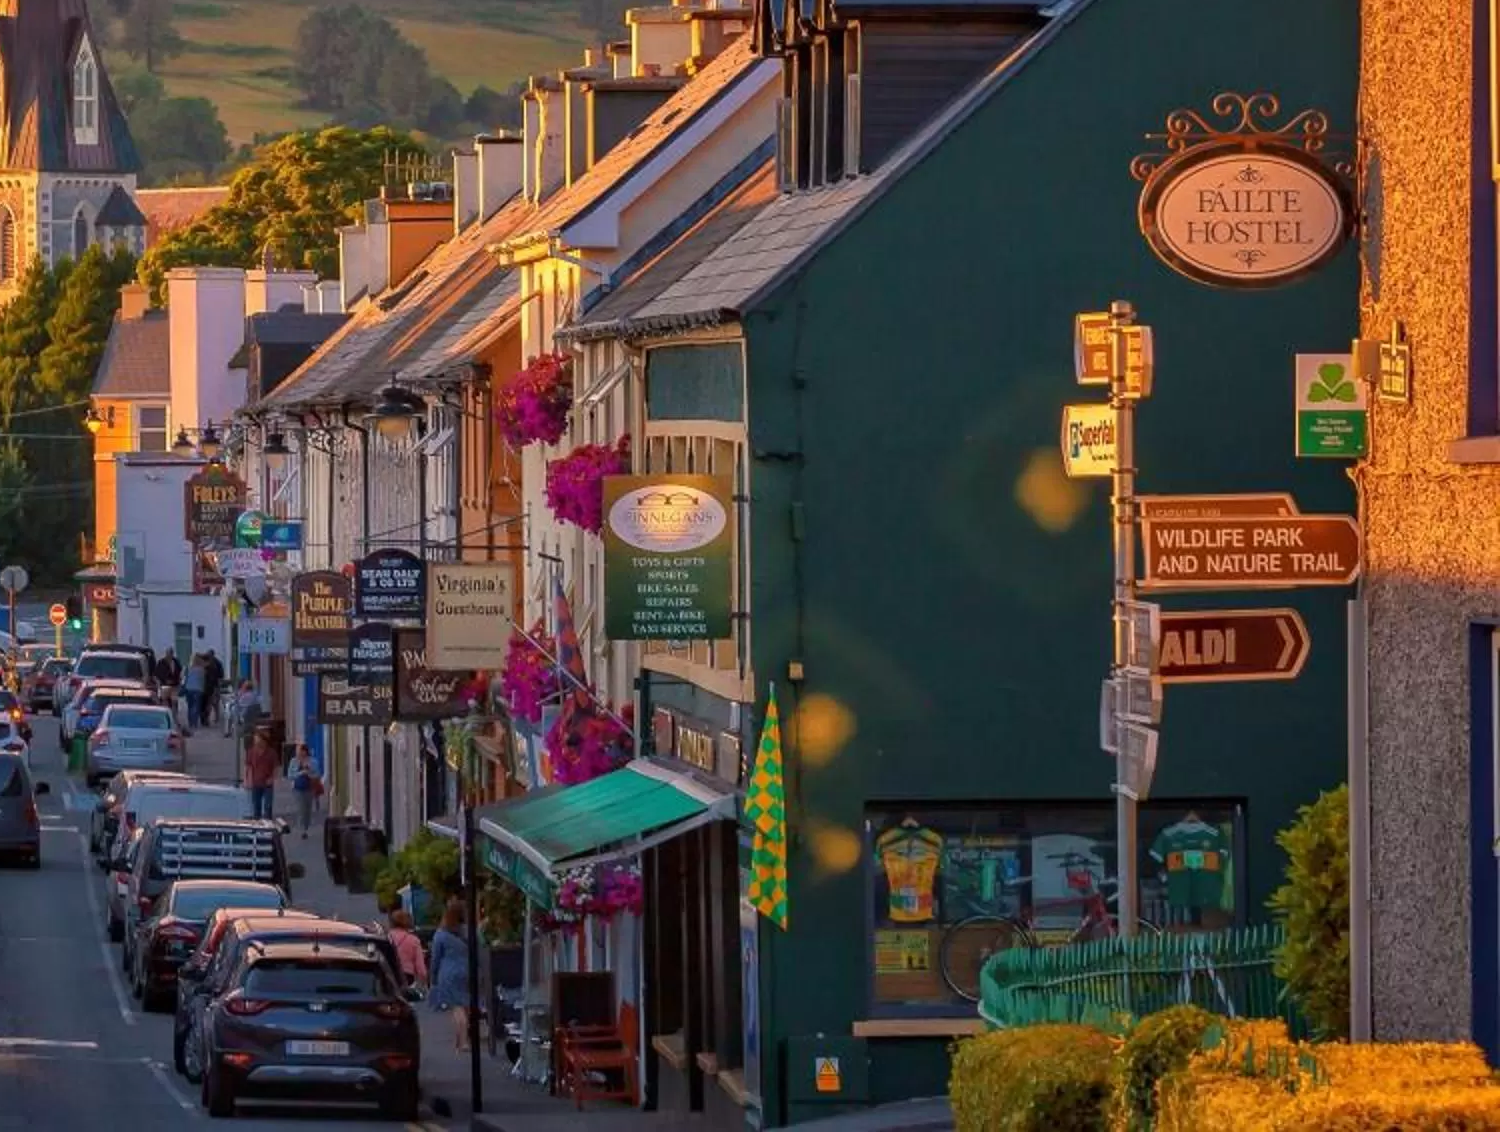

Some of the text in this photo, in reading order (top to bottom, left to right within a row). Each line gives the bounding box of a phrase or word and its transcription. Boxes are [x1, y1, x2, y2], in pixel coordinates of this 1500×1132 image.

[1197, 183, 1301, 213] FÁILTE
[1187, 220, 1313, 245] HOSTEL
[1156, 527, 1304, 549] WILDLIFE PARK
[1157, 553, 1346, 573] AND NATURE TRAIL
[436, 574, 506, 595] Virginia's
[436, 601, 505, 616] Guesthouse
[645, 597, 693, 607] REPAIRS
[631, 623, 707, 634] TAXI SERVICE
[1160, 627, 1236, 667] ALDI
[325, 700, 373, 715] BAR
